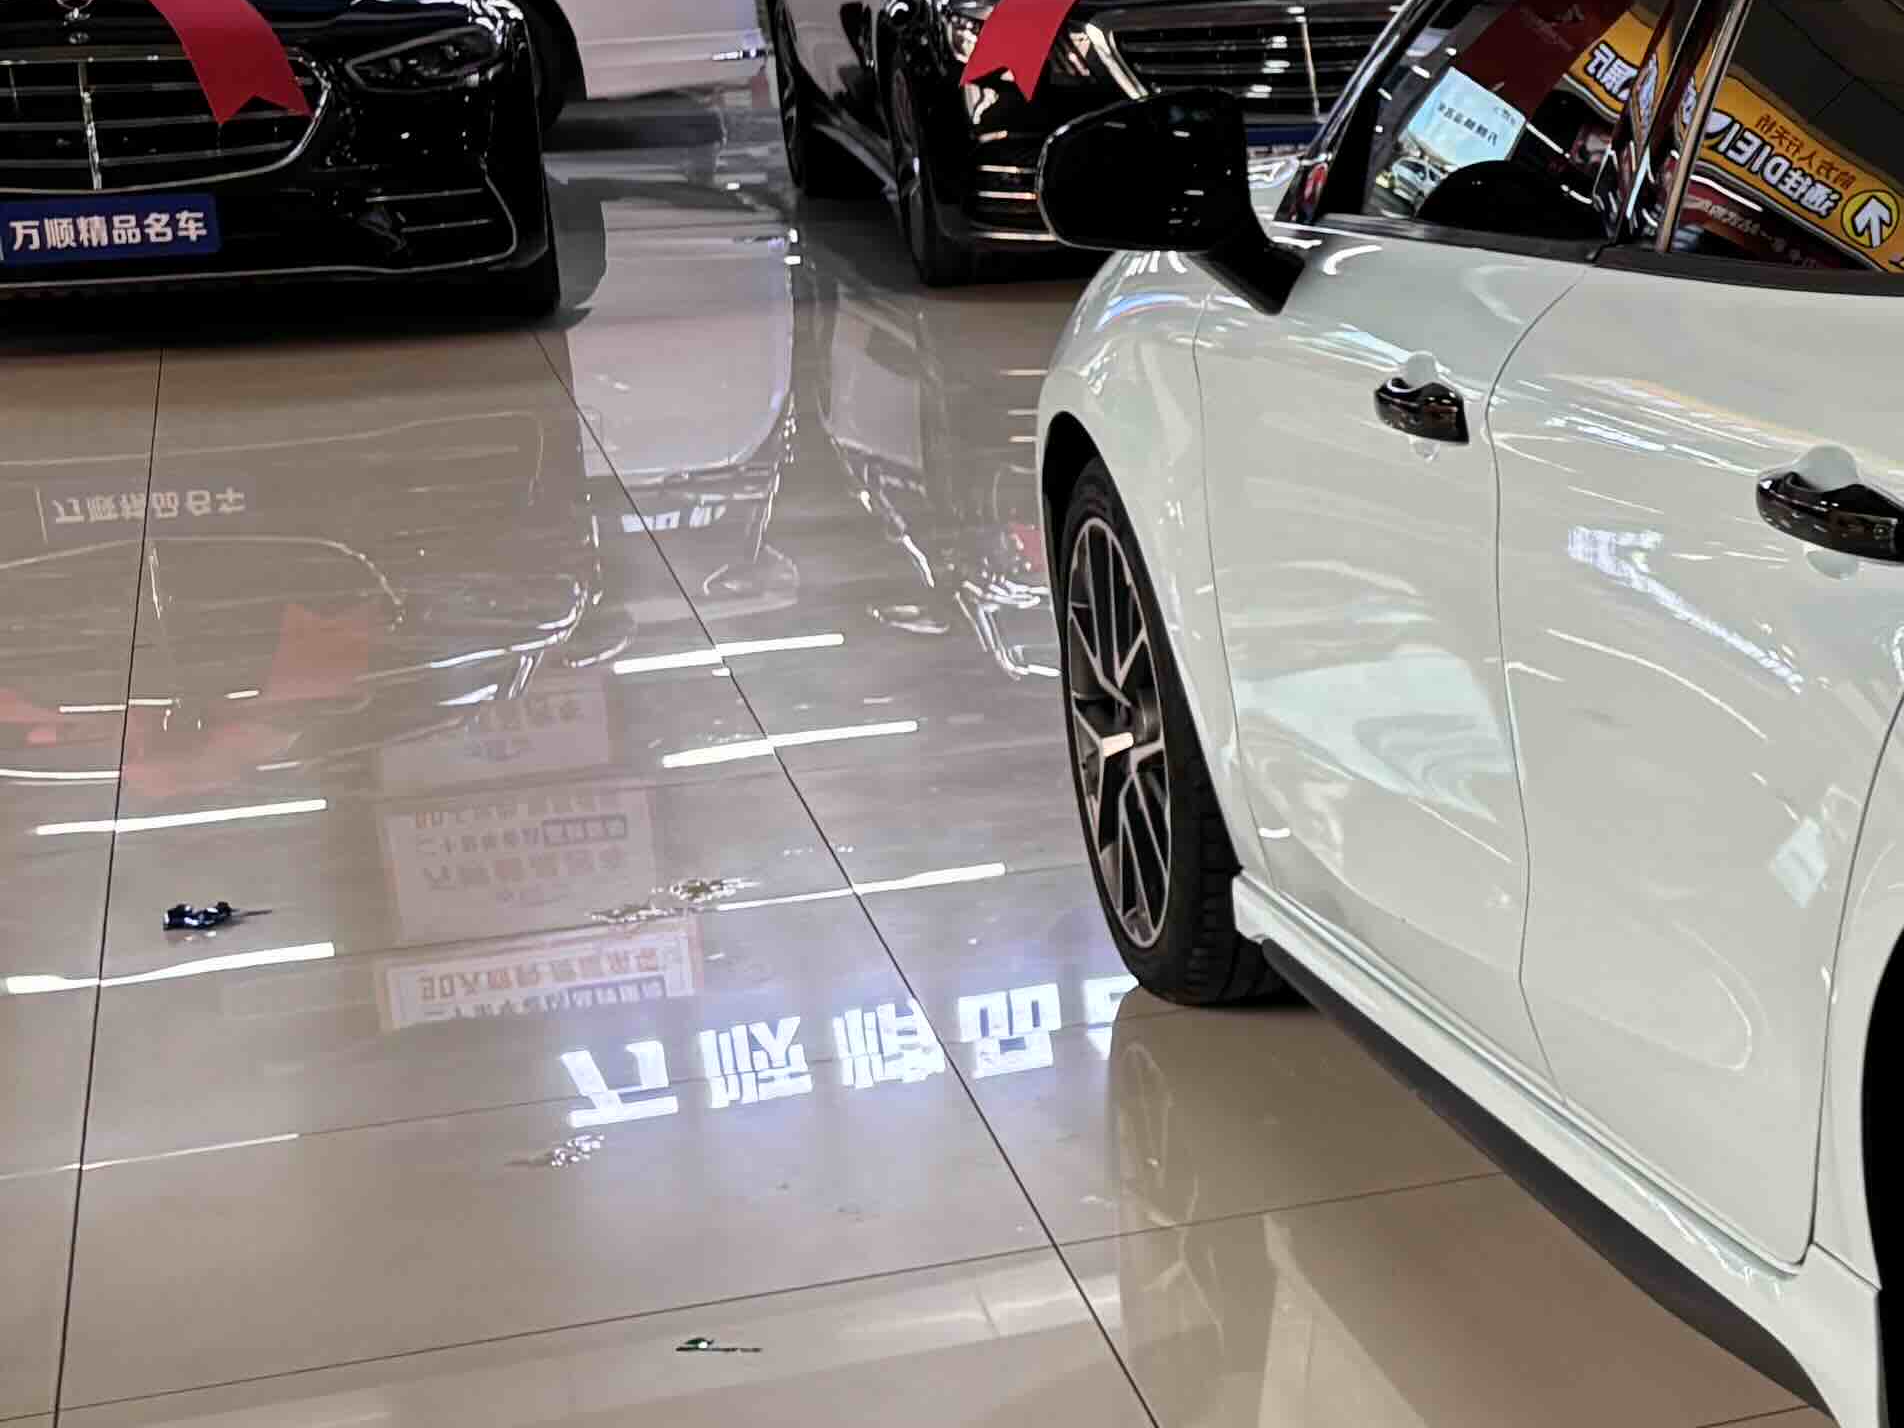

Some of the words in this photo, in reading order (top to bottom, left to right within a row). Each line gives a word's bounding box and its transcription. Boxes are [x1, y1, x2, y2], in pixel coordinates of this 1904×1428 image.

[9, 210, 208, 251] 万顺精品名车
